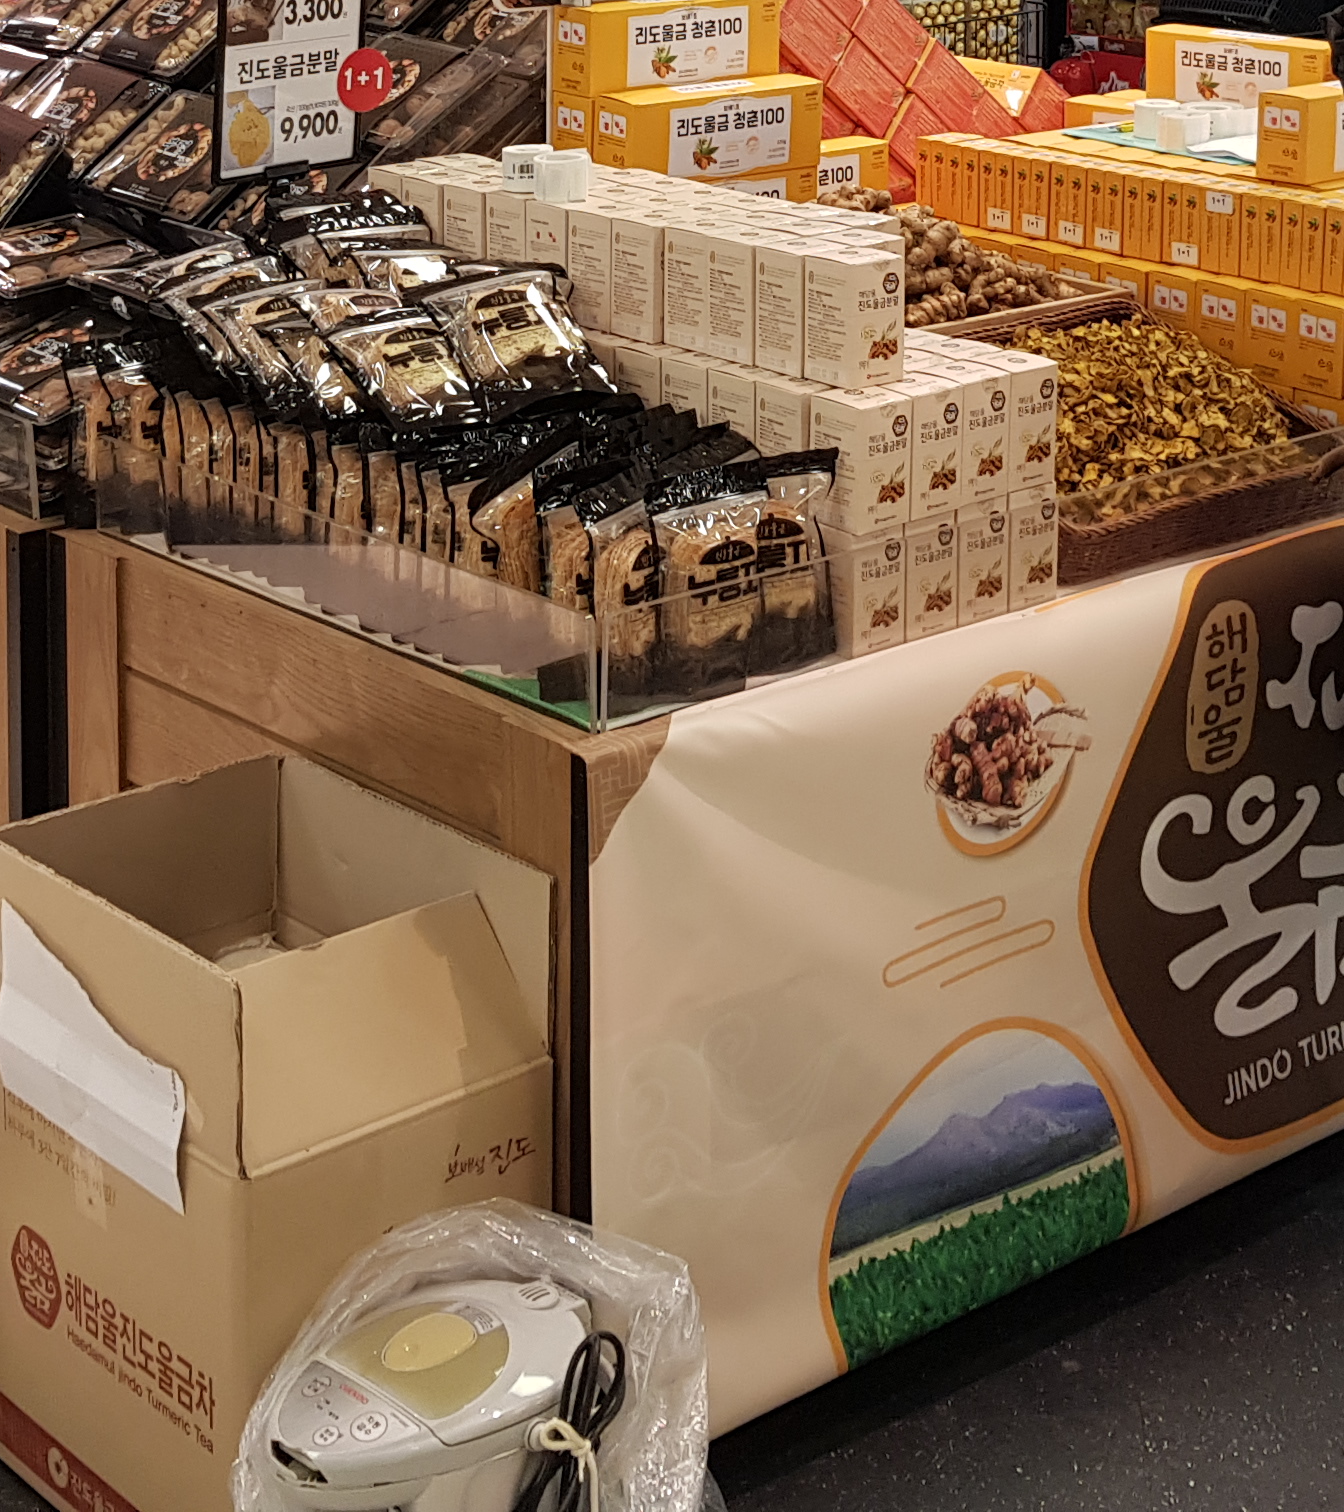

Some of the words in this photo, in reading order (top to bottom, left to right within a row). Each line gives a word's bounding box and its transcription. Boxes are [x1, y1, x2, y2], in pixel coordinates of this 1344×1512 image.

[634, 22, 688, 46] 진도울금
[690, 16, 743, 39] 청춘100
[237, 47, 340, 85] 진도울금분말
[344, 66, 385, 92] 1+1
[1180, 50, 1229, 72] 진도울금
[1231, 56, 1282, 78] 청춘100
[280, 109, 339, 144] 9,900
[676, 114, 730, 138] 진도울금
[733, 106, 785, 130] 청춘100
[1223, 1046, 1293, 1107] JINDO
[489, 1137, 537, 1175] 진도
[65, 1272, 216, 1430] 해담울진도울금차
[146, 1387, 192, 1437] Turmeric
[193, 1423, 215, 1456] Tea
